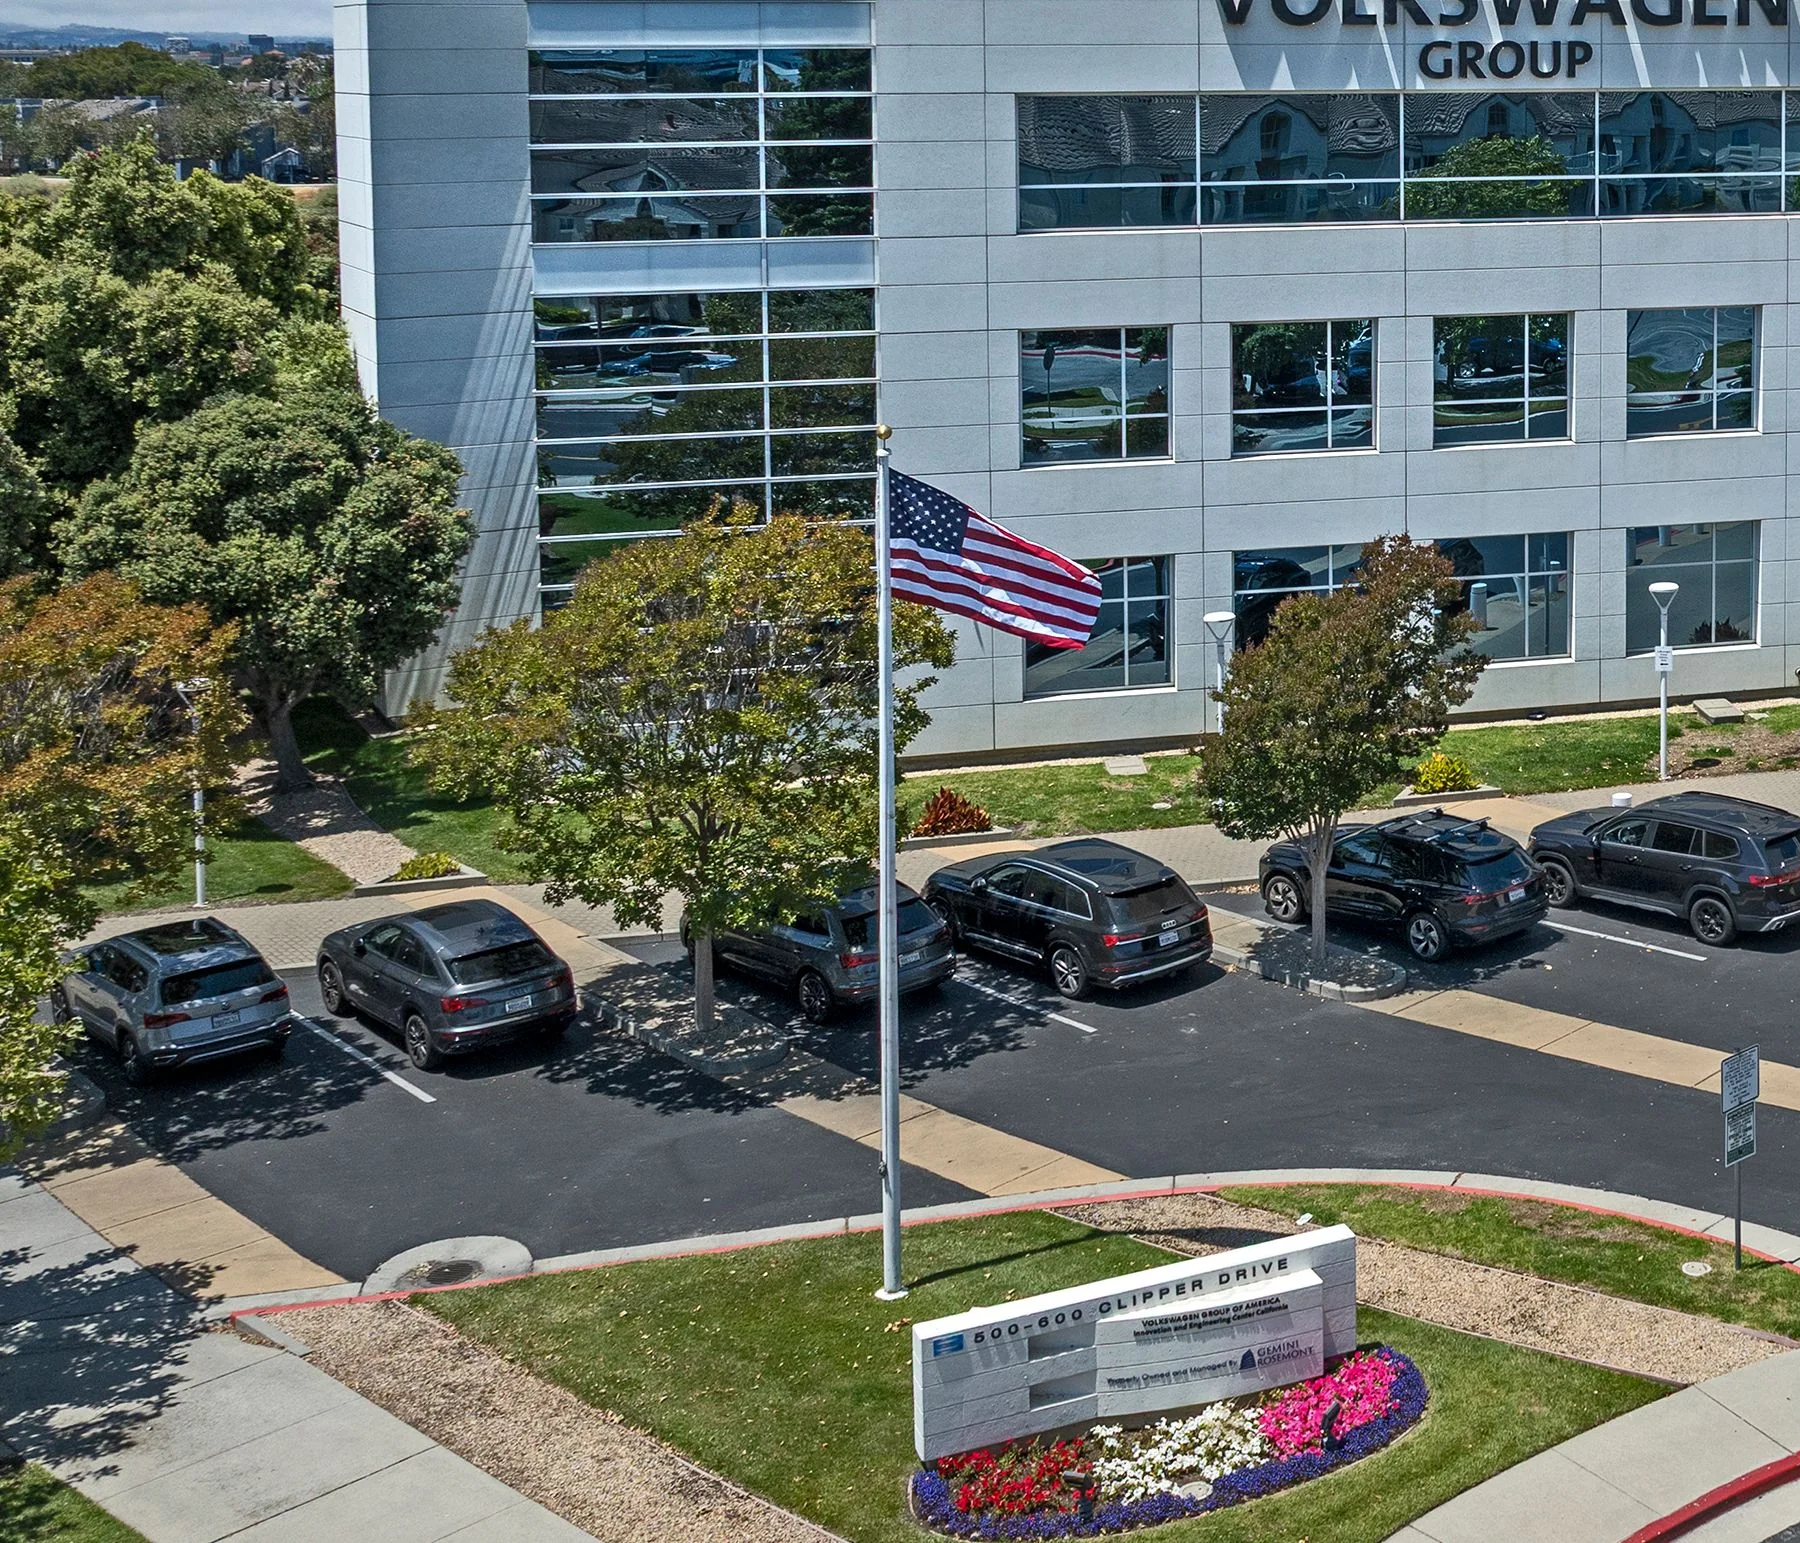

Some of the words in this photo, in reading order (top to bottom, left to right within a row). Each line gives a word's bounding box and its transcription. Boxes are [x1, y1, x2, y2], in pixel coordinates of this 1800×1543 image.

[1418, 40, 1593, 79] GROUP
[973, 1309, 1083, 1344] 500-600
[1098, 1279, 1203, 1314] CLIPPER
[1218, 1258, 1288, 1286] DRIVE
[1141, 1312, 1200, 1327] VOLKSWAGEN
[1201, 1307, 1230, 1319] GROUP
[1232, 1304, 1243, 1313] OF
[1244, 1297, 1280, 1310] AMERICA
[1133, 1326, 1172, 1337] Innovation
[1174, 1323, 1187, 1332] and
[1189, 1316, 1231, 1329] Engineering
[1232, 1311, 1255, 1321] Center
[1256, 1303, 1288, 1316] California
[1257, 1340, 1299, 1357] GEMINI
[1257, 1345, 1314, 1366] ROSEMONT
